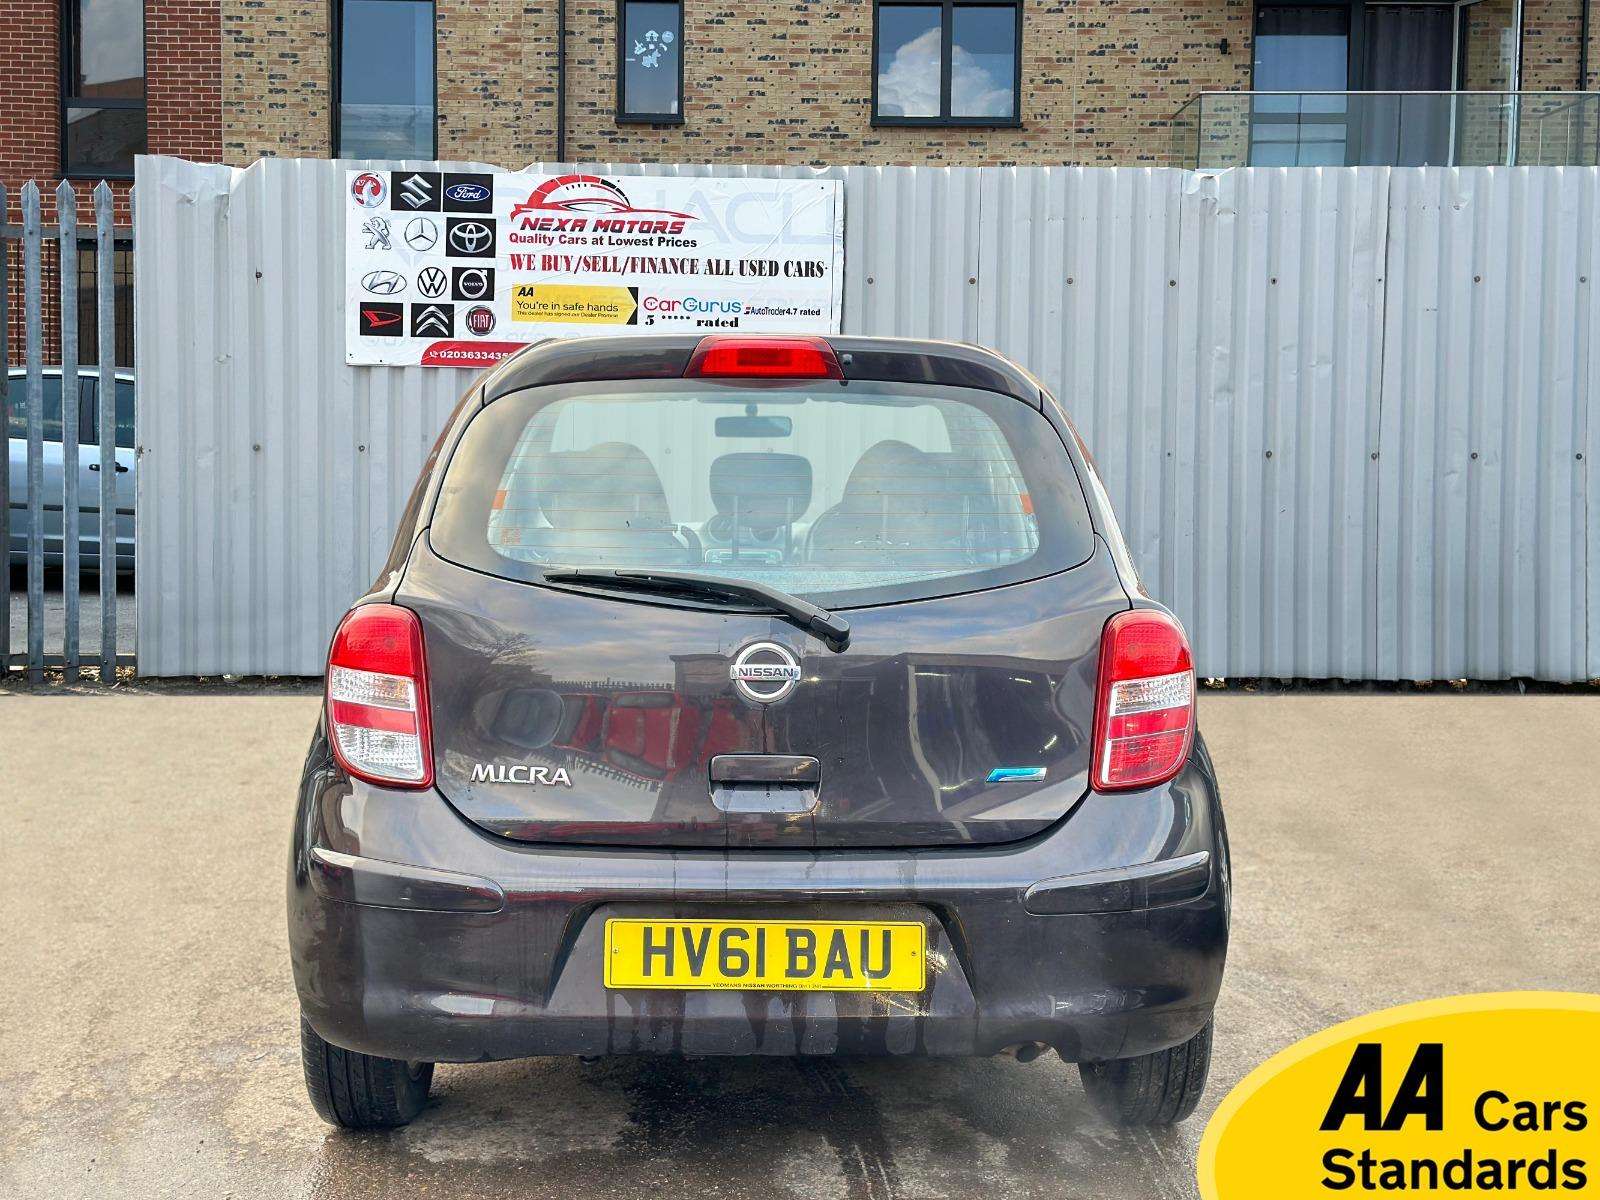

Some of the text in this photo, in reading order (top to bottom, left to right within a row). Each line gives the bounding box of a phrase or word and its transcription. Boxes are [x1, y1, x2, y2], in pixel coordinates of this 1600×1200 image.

[454, 186, 482, 199] Ford
[520, 217, 686, 235] NEXA MOTORS
[509, 232, 698, 248] Quality Cars at Lowest Prices
[509, 253, 536, 271] WE
[703, 258, 734, 276] ALL
[739, 259, 780, 277] USED
[783, 260, 825, 278] CARS
[517, 286, 535, 297] AA
[516, 300, 619, 313] You're in safe hands
[643, 296, 743, 313] CarGurus
[799, 308, 821, 316] rated
[473, 314, 490, 328] FIAT
[645, 315, 739, 328] 5 rated
[738, 667, 794, 677] NISSAN
[470, 763, 572, 787] MICRA
[642, 926, 893, 980] HV61 BAU
